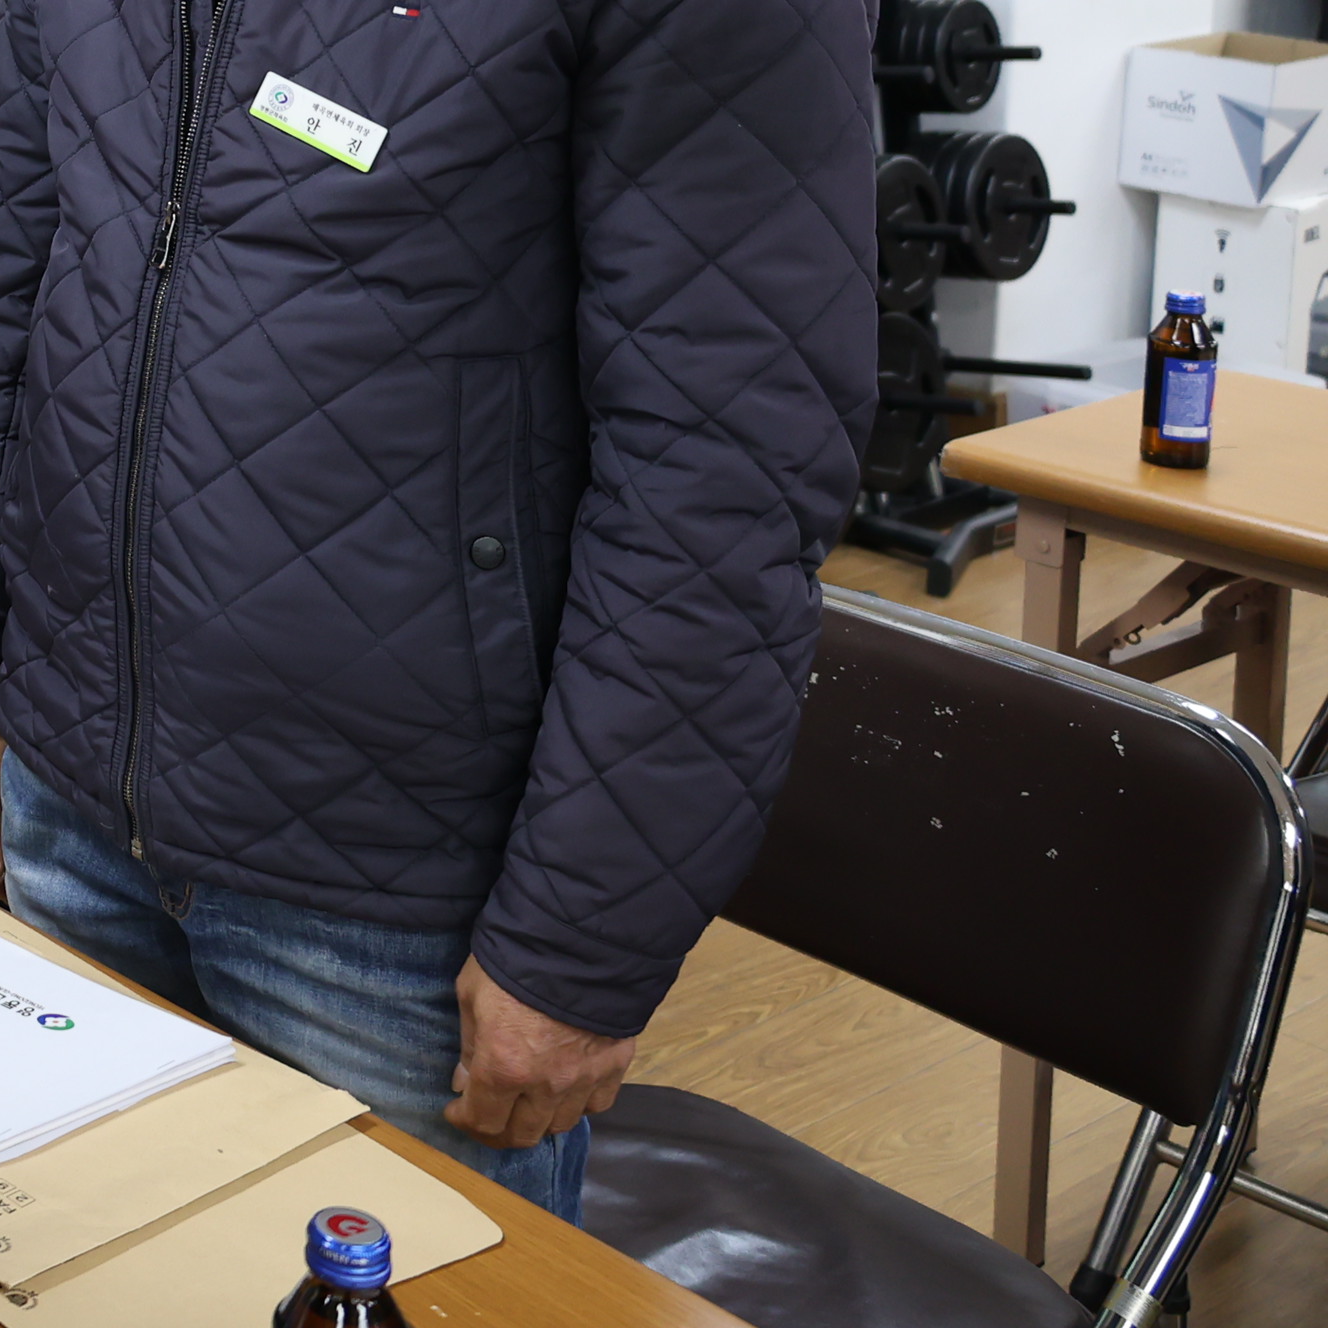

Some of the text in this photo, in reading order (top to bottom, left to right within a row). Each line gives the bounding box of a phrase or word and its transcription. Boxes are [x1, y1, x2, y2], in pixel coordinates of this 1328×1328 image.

[1147, 95, 1197, 115] Sindoh
[307, 117, 363, 157] 안 진
